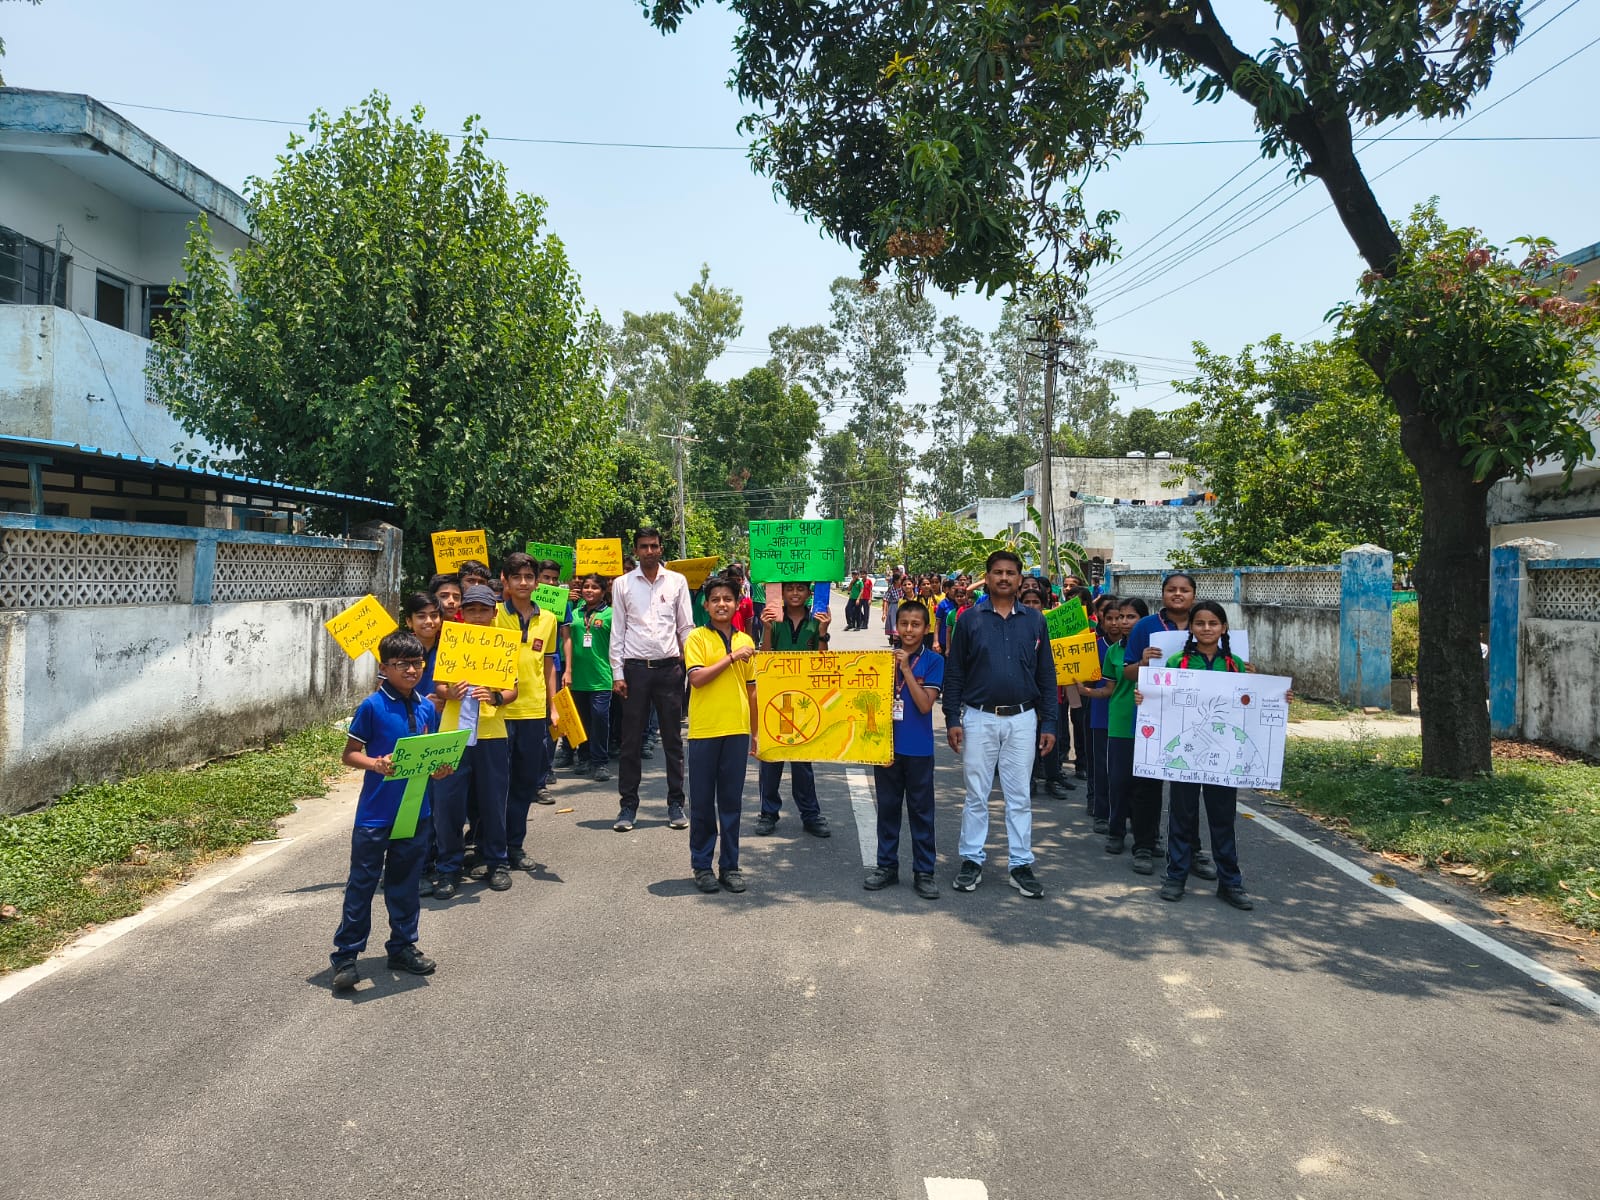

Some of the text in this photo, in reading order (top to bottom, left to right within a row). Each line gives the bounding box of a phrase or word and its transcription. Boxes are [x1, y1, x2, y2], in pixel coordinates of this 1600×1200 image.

[799, 522, 823, 536] भारत
[790, 549, 812, 560] भारत
[818, 548, 839, 562] की
[776, 561, 805, 575] पहचान
[444, 628, 518, 657] Say No to Drugs
[439, 651, 514, 682] Say Yes to Life
[773, 658, 803, 675] नशा
[1062, 662, 1081, 674] नशा
[808, 670, 845, 688] सपने
[395, 740, 460, 762] Be Smart
[392, 761, 424, 777] Don't
[1135, 764, 1156, 776] Know
[1161, 767, 1174, 779] The
